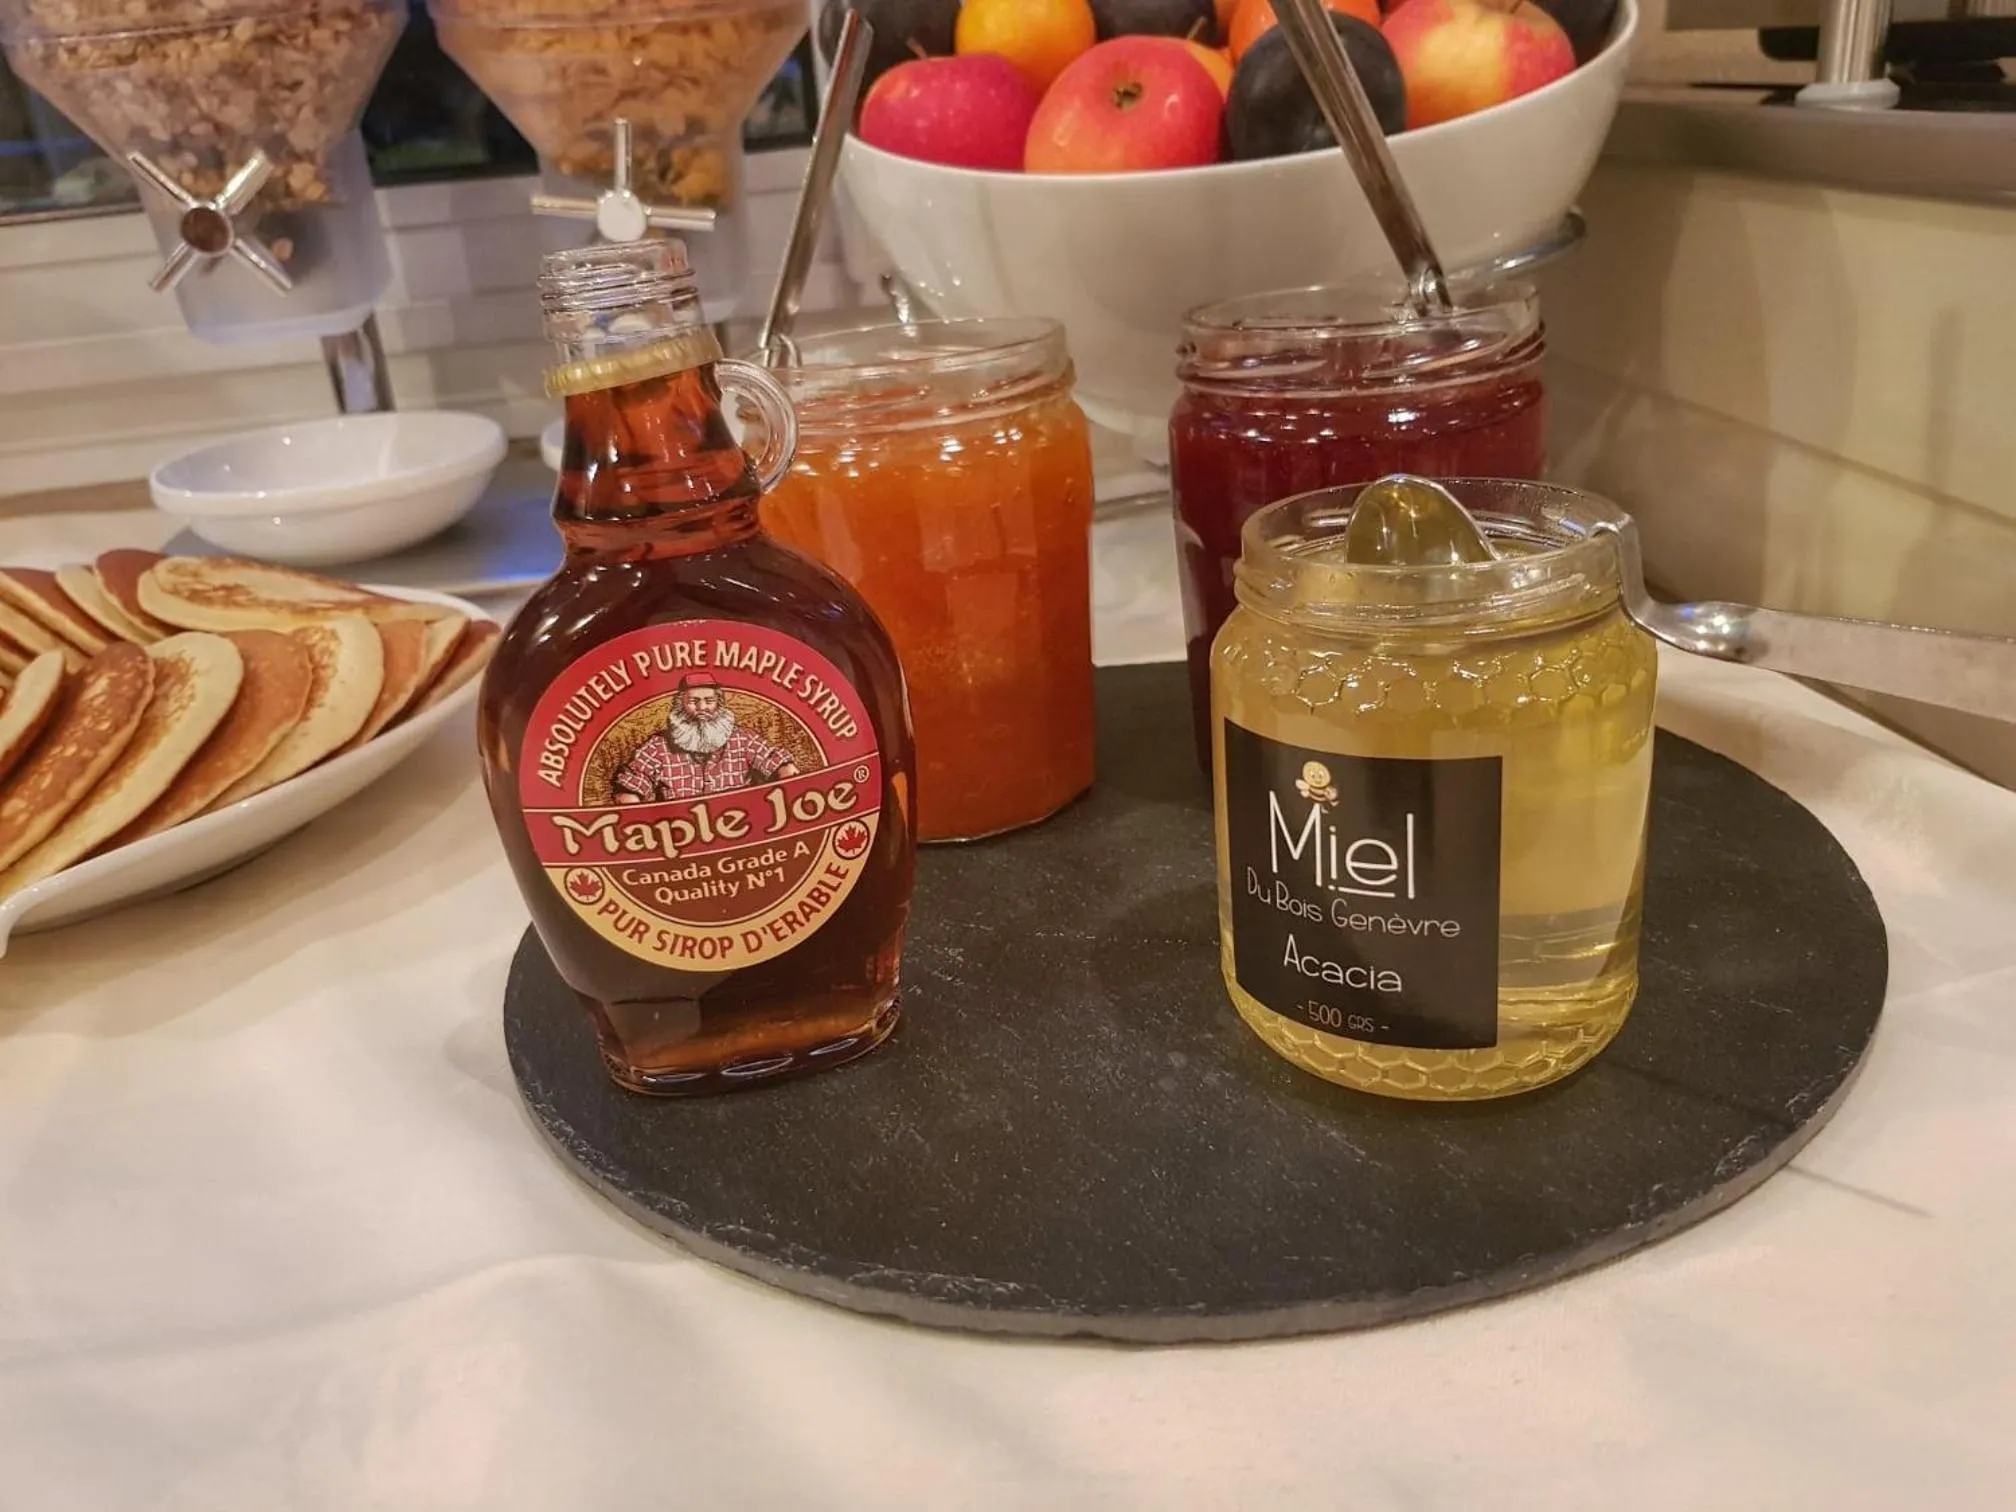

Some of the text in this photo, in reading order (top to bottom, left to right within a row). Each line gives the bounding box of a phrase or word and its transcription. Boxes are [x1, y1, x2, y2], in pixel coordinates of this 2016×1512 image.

[537, 640, 858, 787] ABSOLUTELY PURE MAPLE SYRUP
[552, 803, 751, 859] Maple
[1269, 790, 1414, 899] Miel
[623, 843, 810, 887] Canada Grade A
[655, 879, 739, 905] Quality
[596, 862, 849, 959] PUR SIROP D'ERABLE
[1331, 898, 1461, 938] Genèvre
[1283, 934, 1403, 993] Acacia
[1308, 999, 1342, 1028] 500
